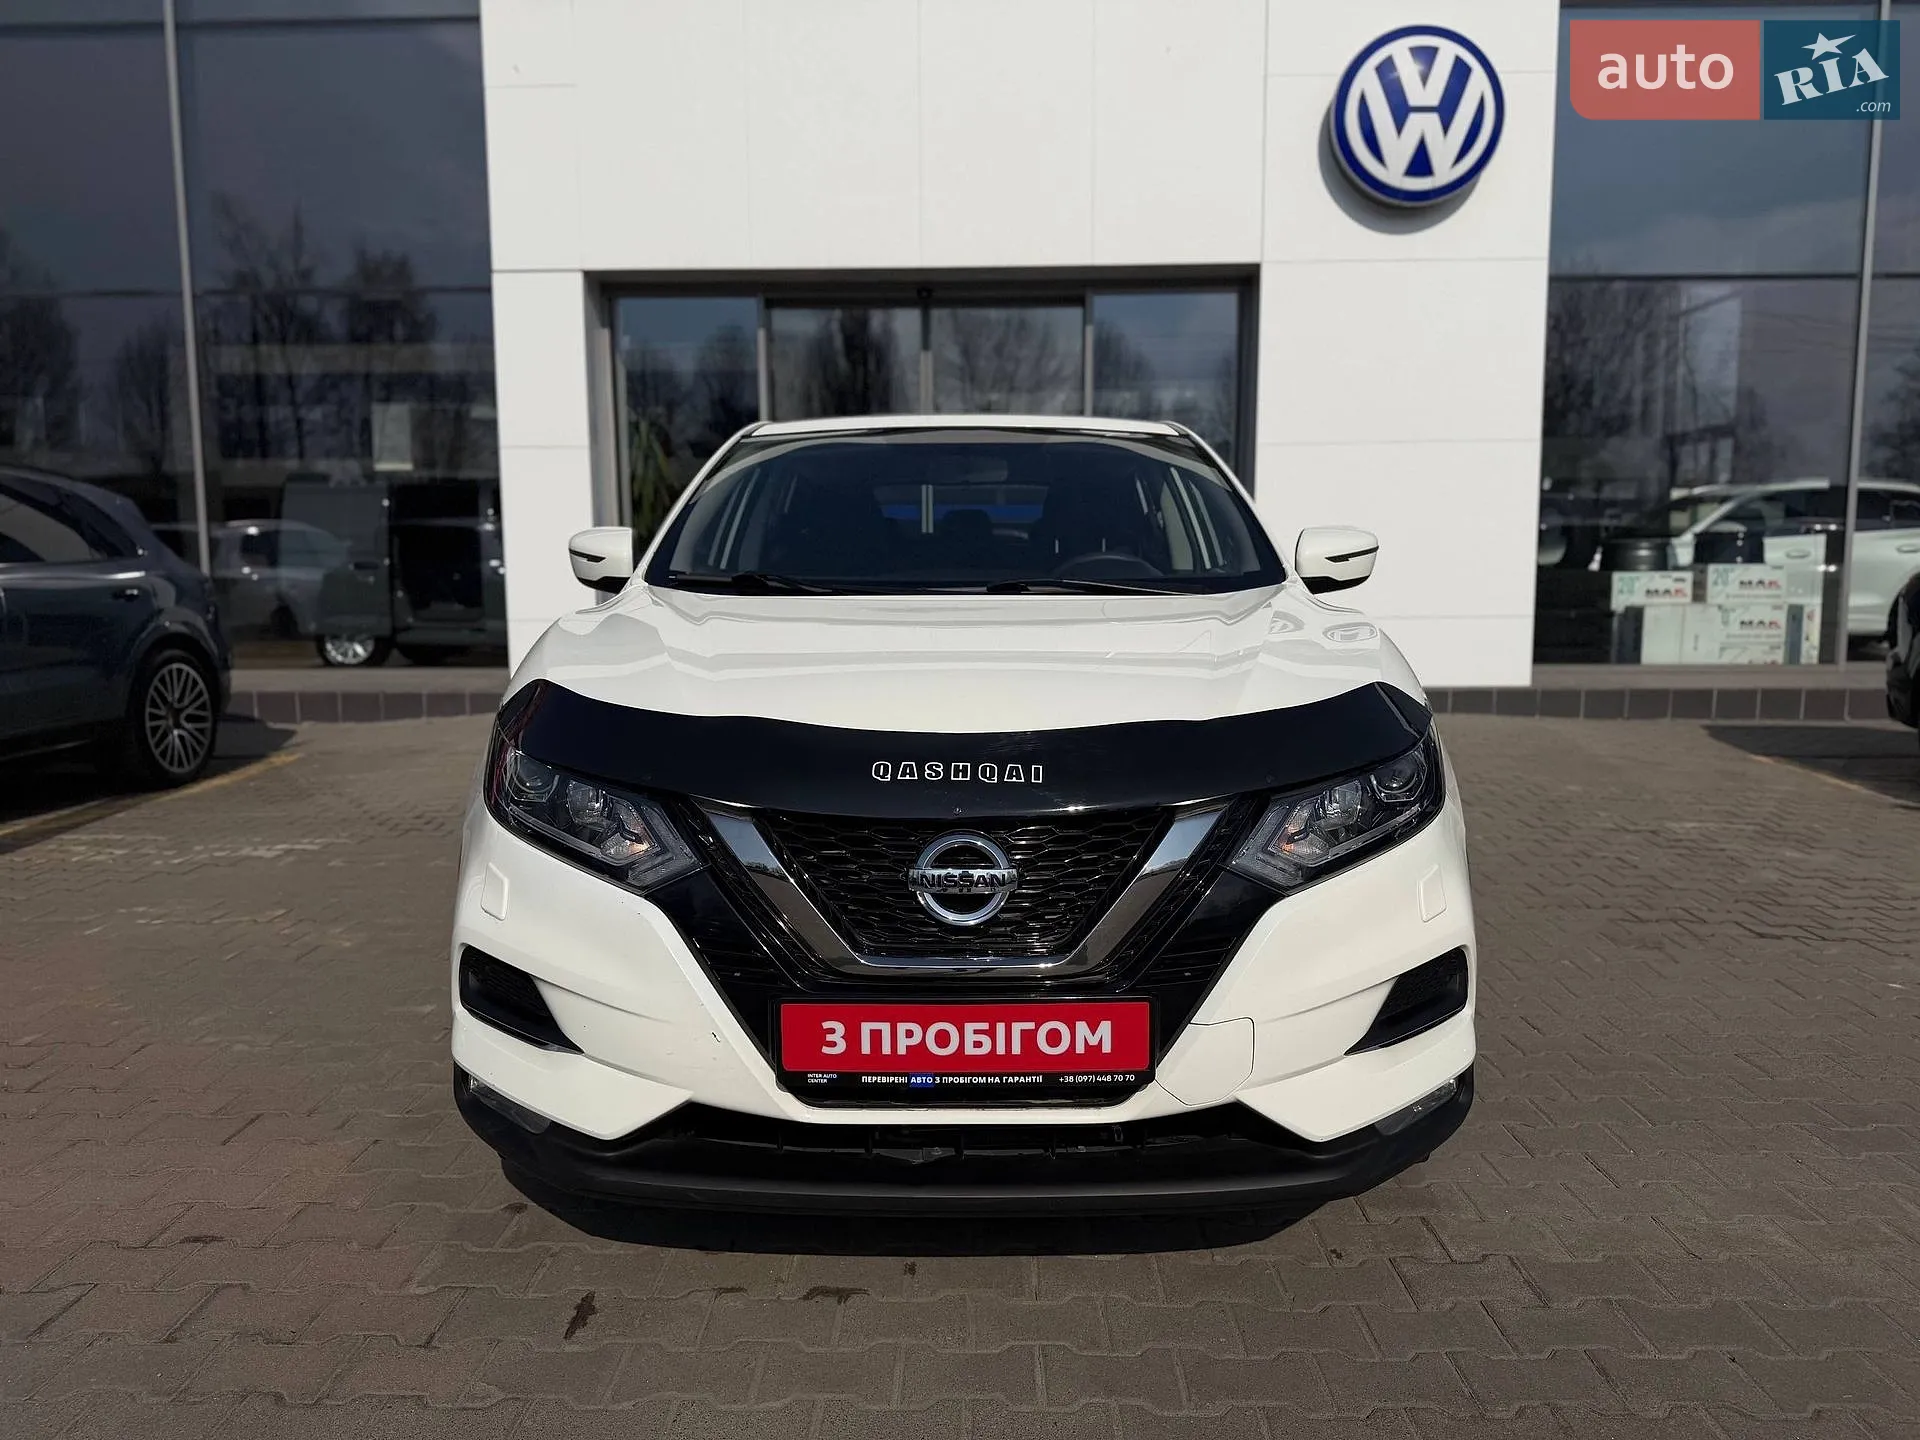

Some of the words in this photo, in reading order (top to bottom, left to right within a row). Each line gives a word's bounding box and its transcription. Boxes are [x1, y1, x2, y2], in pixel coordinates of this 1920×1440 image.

[871, 761, 1044, 784] QASHQAI
[919, 873, 1007, 890] NISSAN
[821, 1021, 847, 1054] З
[860, 1020, 1112, 1056] ПРОБІГОМ
[942, 1076, 986, 1084] ПРОБІГОМ
[1002, 1075, 1043, 1083] ГАРАНТІЇ
[1059, 1075, 1074, 1083] +38
[1075, 1074, 1096, 1083] (097)
[1113, 1074, 1124, 1082] 70
